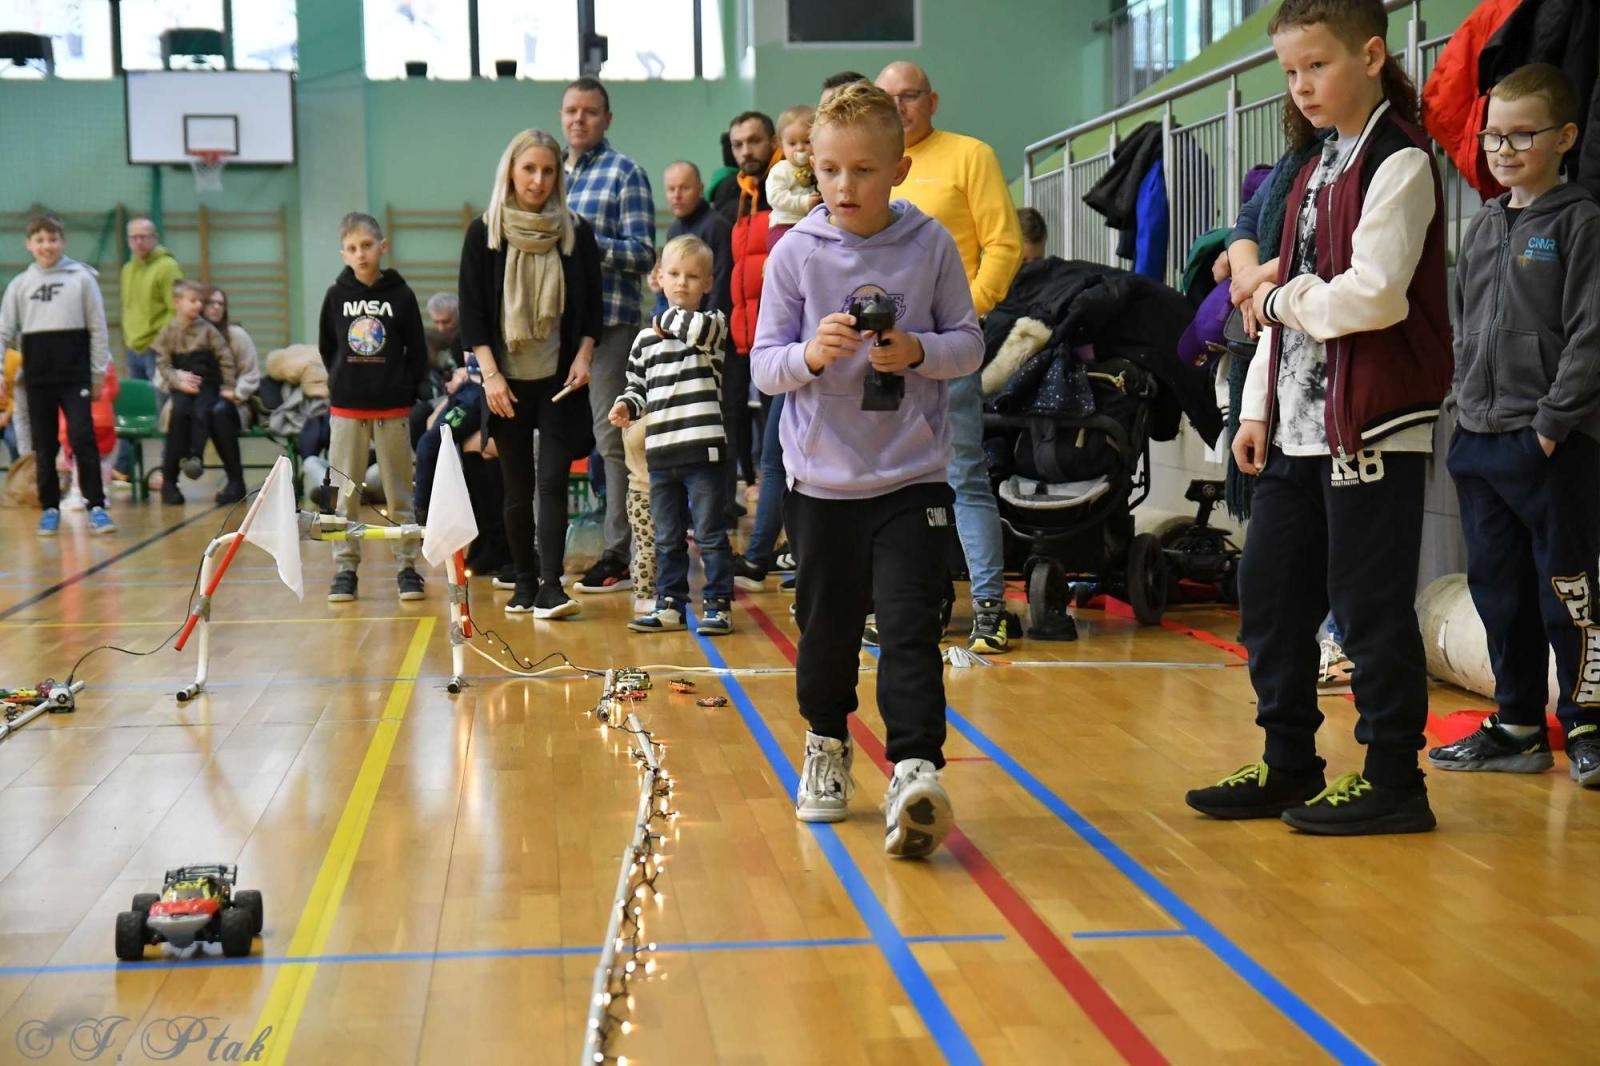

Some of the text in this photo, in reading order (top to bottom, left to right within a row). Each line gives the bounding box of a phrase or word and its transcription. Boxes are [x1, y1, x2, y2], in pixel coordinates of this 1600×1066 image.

[30, 282, 64, 301] 4F
[343, 299, 393, 317] NASA
[1331, 448, 1384, 483] K8
